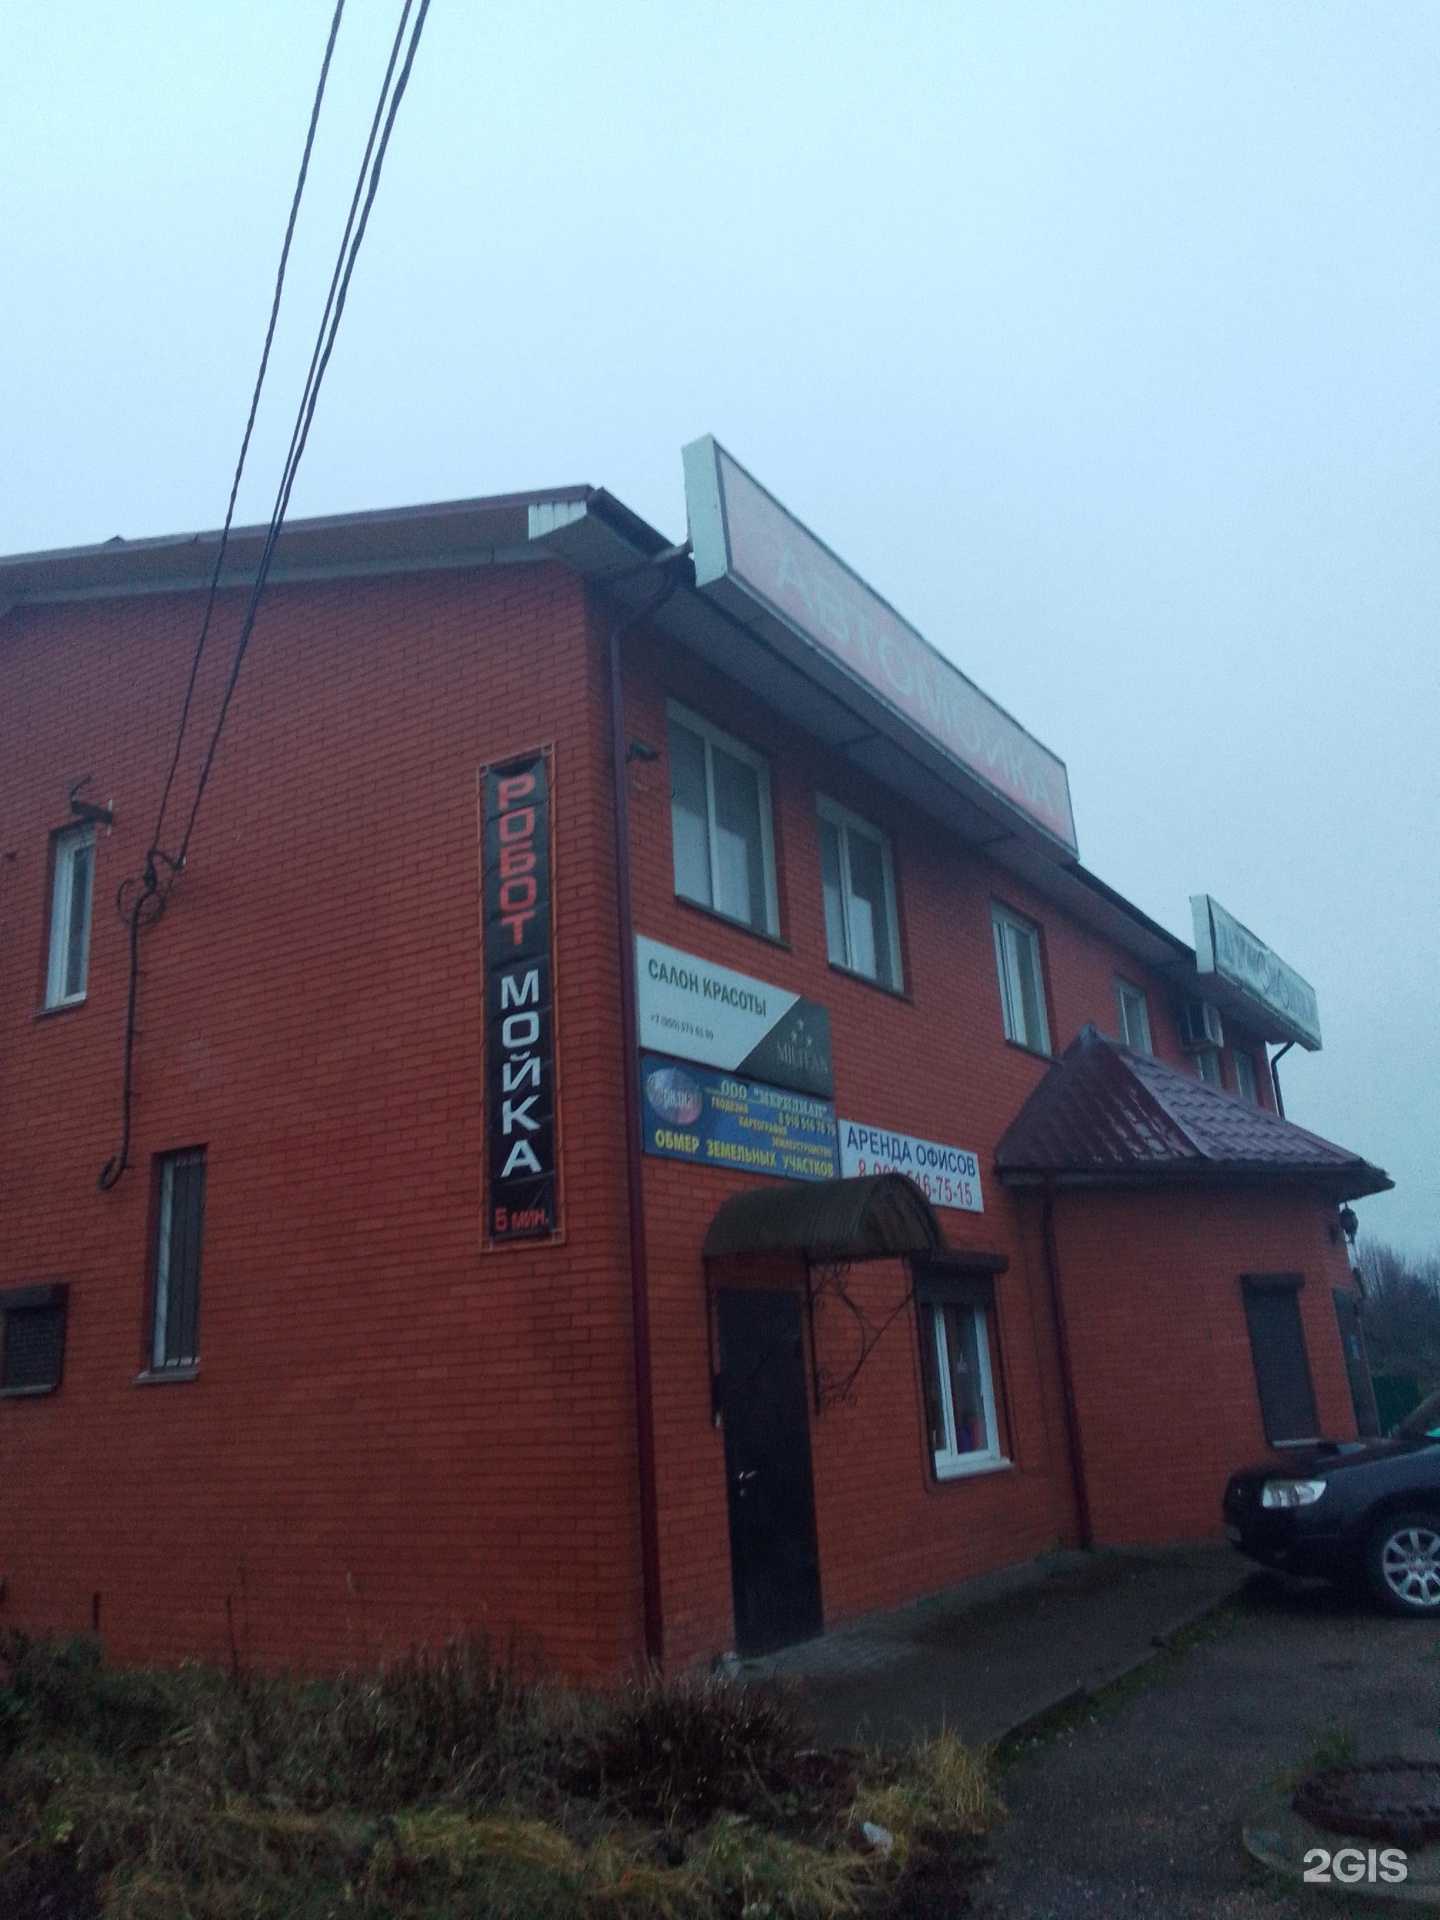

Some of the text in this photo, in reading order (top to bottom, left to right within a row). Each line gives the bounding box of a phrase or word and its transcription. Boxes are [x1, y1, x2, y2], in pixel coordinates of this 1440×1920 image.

[499, 772, 543, 1178] РОБОТ МОЙКА
[648, 958, 767, 1017] САЛОН КРАСОТЫ
[655, 1128, 834, 1178] ОБМЕР ЗЕМЕЛЬНЫХ УЧАСТКОВ
[847, 1126, 976, 1178] АРЕНДА ОФИСОВ
[495, 1207, 508, 1232] 5
